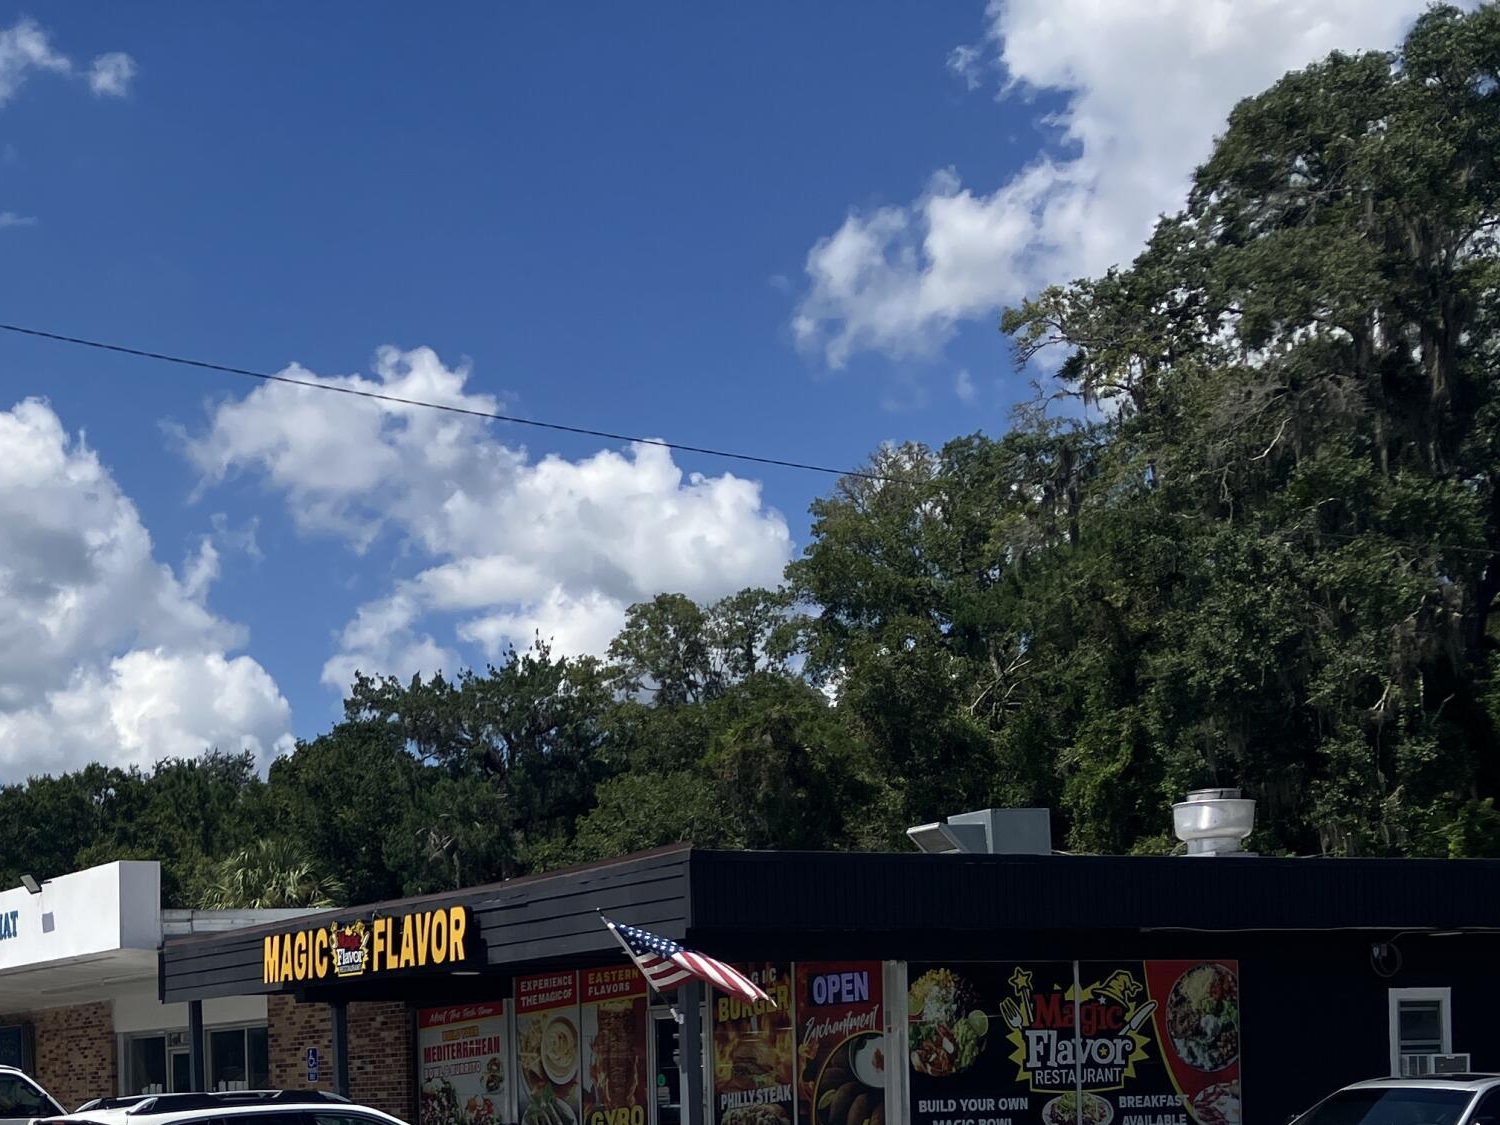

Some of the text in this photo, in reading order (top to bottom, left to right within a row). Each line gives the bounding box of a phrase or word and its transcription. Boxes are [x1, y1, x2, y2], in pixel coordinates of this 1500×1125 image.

[263, 906, 466, 984] MAGIC FLAVOR
[336, 948, 364, 966] Flavor
[520, 975, 573, 992] EXPERIENCE
[587, 968, 639, 985] EASTERN
[588, 982, 630, 997] FLAVORS
[812, 971, 869, 1005] OPEN
[520, 995, 537, 1008] THE
[538, 991, 564, 1004] MAGIC
[1032, 991, 1125, 1037] Magic
[803, 1004, 879, 1045] Enchantment
[1024, 1028, 1134, 1069] Flavor
[1035, 1067, 1122, 1085] RESTAURANT
[720, 1084, 792, 1110] PHILLY STEAK
[918, 1097, 1029, 1113] BUILD YOUR OWN
[1118, 1094, 1190, 1109] BREAKFAST
